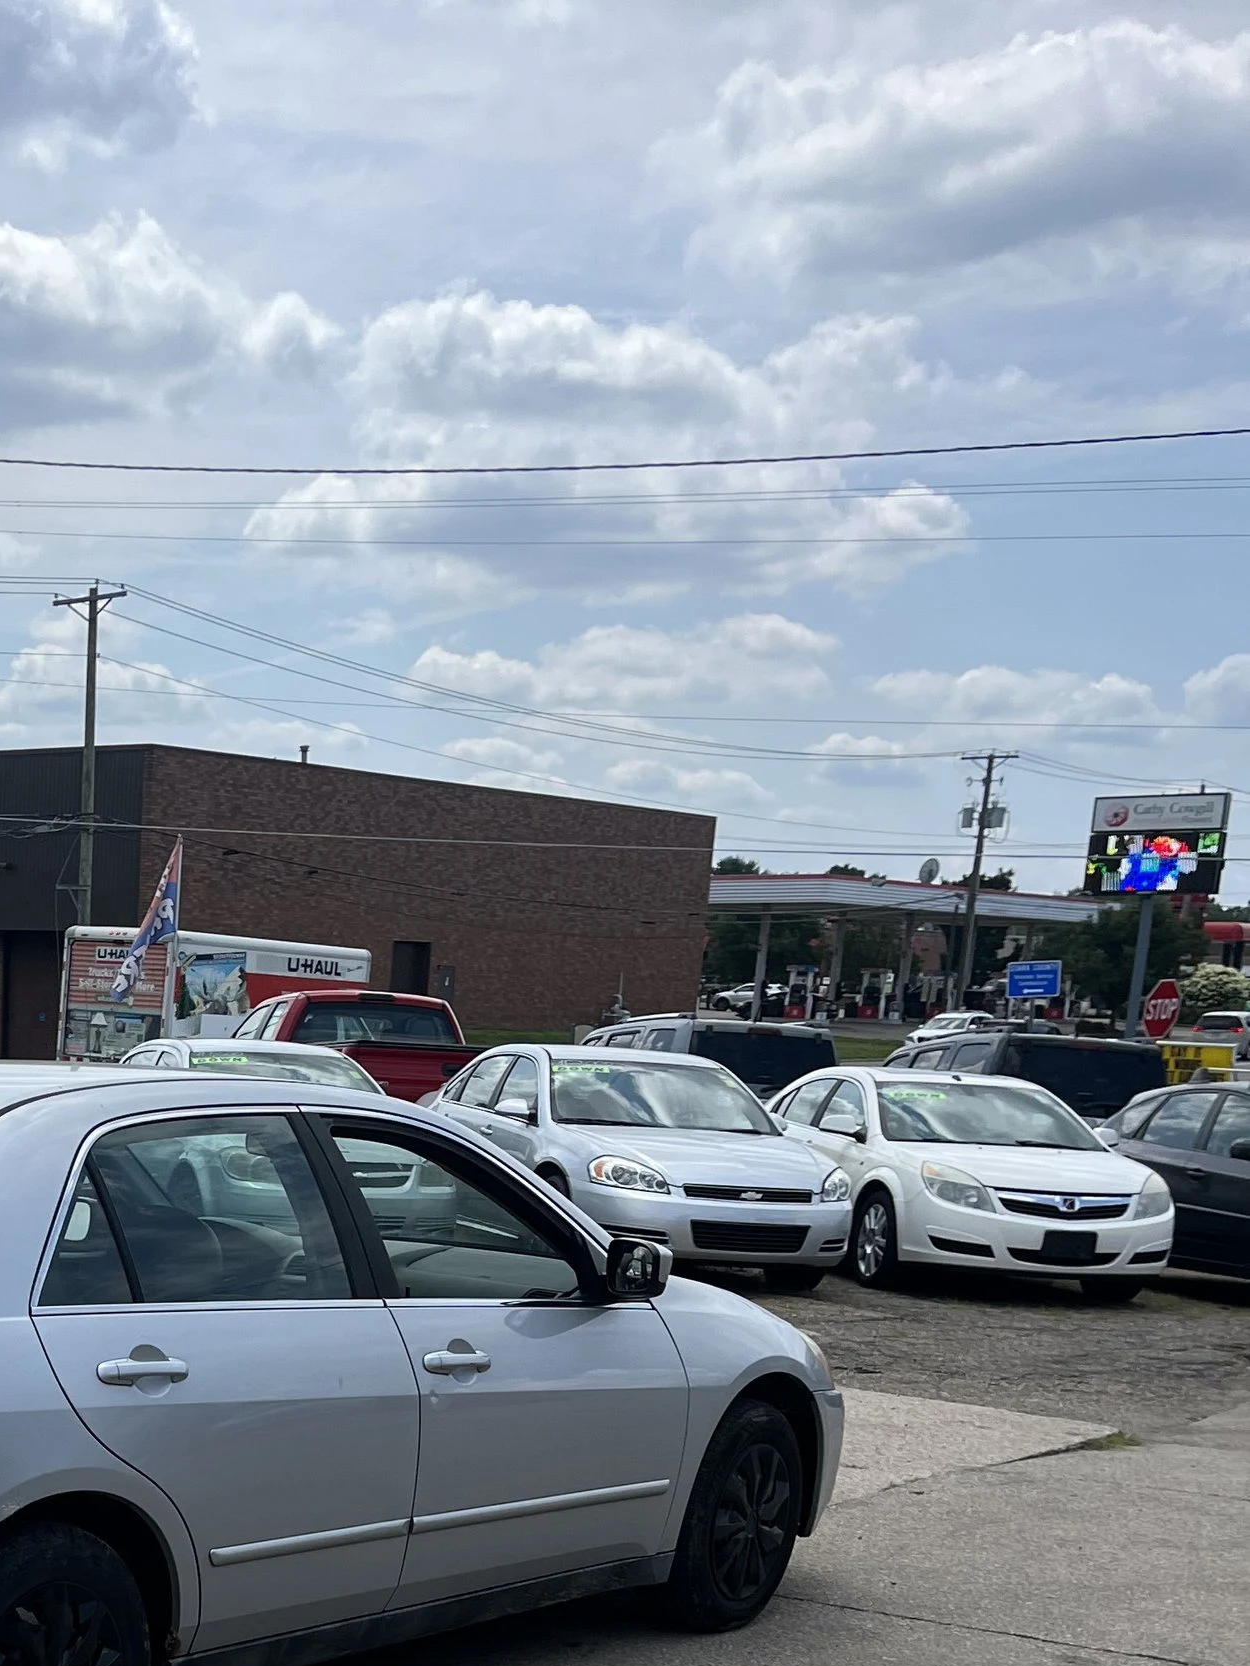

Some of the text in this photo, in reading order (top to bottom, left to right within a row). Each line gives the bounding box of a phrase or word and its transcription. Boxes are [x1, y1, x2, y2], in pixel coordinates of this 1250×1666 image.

[97, 948, 130, 959] U-HA
[287, 956, 342, 977] U-HAUL
[1145, 998, 1179, 1020] STOP
